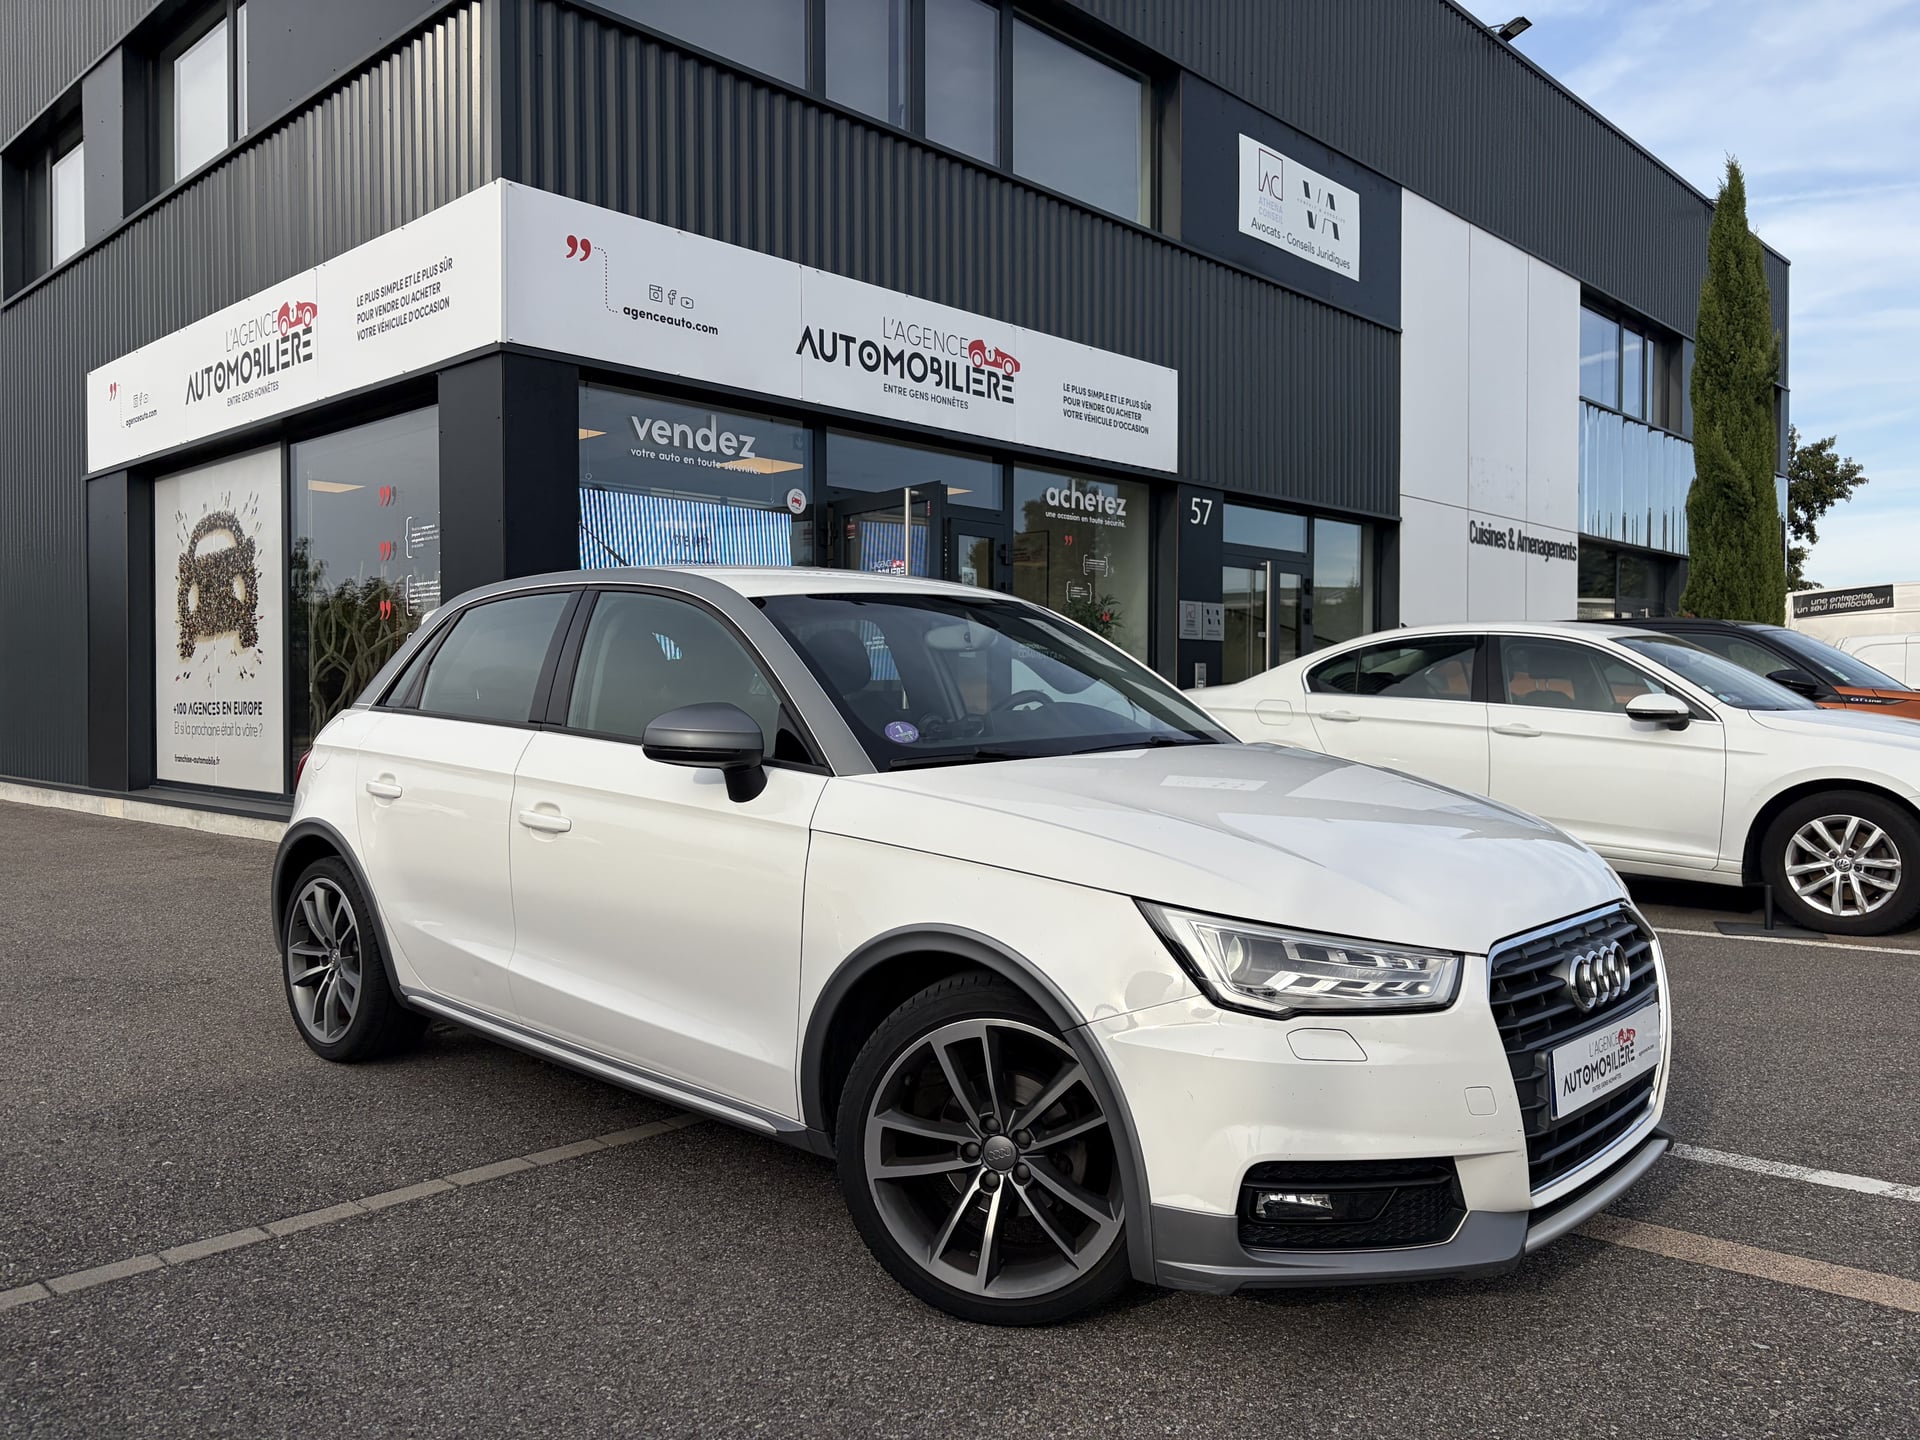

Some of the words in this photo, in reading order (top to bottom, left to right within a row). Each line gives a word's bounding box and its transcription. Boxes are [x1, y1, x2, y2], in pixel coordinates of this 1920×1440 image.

[1251, 217, 1281, 239] Avocats
[1286, 232, 1315, 254] Conseils
[1316, 246, 1350, 270] Juridiques
[356, 295, 363, 307] LE
[364, 288, 380, 304] PLUS
[381, 279, 404, 297] SIMPLE
[405, 275, 412, 288] ET
[413, 271, 420, 284] LE
[422, 264, 438, 280] PLUS
[439, 256, 453, 273] SÛR
[357, 308, 374, 324] POUR
[375, 298, 399, 317] VENDRE
[400, 294, 410, 307] OU
[411, 282, 441, 304] ACHETER
[225, 309, 278, 352] L'AGENCE
[357, 325, 376, 341] VOTRE
[377, 313, 407, 334] VÉHICULE
[408, 296, 450, 322] D'OCCASION
[623, 305, 718, 336] agenceauto.com
[883, 316, 968, 359] L'AGENCE
[227, 394, 241, 407] ENTRE
[242, 389, 254, 402] GENS
[883, 384, 907, 397] ENTRE
[909, 389, 929, 402] GENS
[930, 393, 969, 410] HONNÊTES
[1063, 383, 1070, 392] LE
[1071, 385, 1086, 396] PLUS
[1087, 389, 1109, 401] SIMPLE
[1110, 394, 1117, 403] ET
[1118, 396, 1124, 405] LE
[1126, 398, 1140, 408] PLUS
[1140, 400, 1152, 411] SÛR
[1063, 396, 1080, 407] POUR
[1081, 400, 1105, 412] VENDRE
[1106, 406, 1115, 414] OU
[1116, 408, 1142, 420] ACHETER
[1063, 408, 1083, 420] VOTRE
[1084, 411, 1112, 427] VÉHICULE
[1113, 420, 1149, 434] D'OCCASION
[631, 414, 756, 458] vendez
[630, 448, 656, 459] votre
[659, 452, 680, 463] auto
[698, 458, 721, 469] toute
[1046, 479, 1127, 516] achetez
[1191, 497, 1212, 526] 57
[1057, 513, 1080, 521] occasion
[1089, 516, 1103, 525] toute
[1470, 520, 1506, 549] Cuisines
[1508, 528, 1515, 551] &
[1517, 529, 1577, 562] Amenagements
[1810, 598, 1827, 606] une
[1810, 604, 1828, 612] seul
[1829, 598, 1884, 610] interlocuteur
[173, 702, 187, 715] +100
[188, 702, 220, 716] AGENCES
[222, 702, 232, 715] EN
[234, 701, 262, 715] EUROPE
[175, 721, 180, 735] Et
[180, 722, 184, 735] si
[185, 721, 190, 735] la
[192, 722, 220, 739] prochaine
[221, 722, 234, 736] était
[235, 722, 241, 736] la
[242, 723, 258, 737] vôtre
